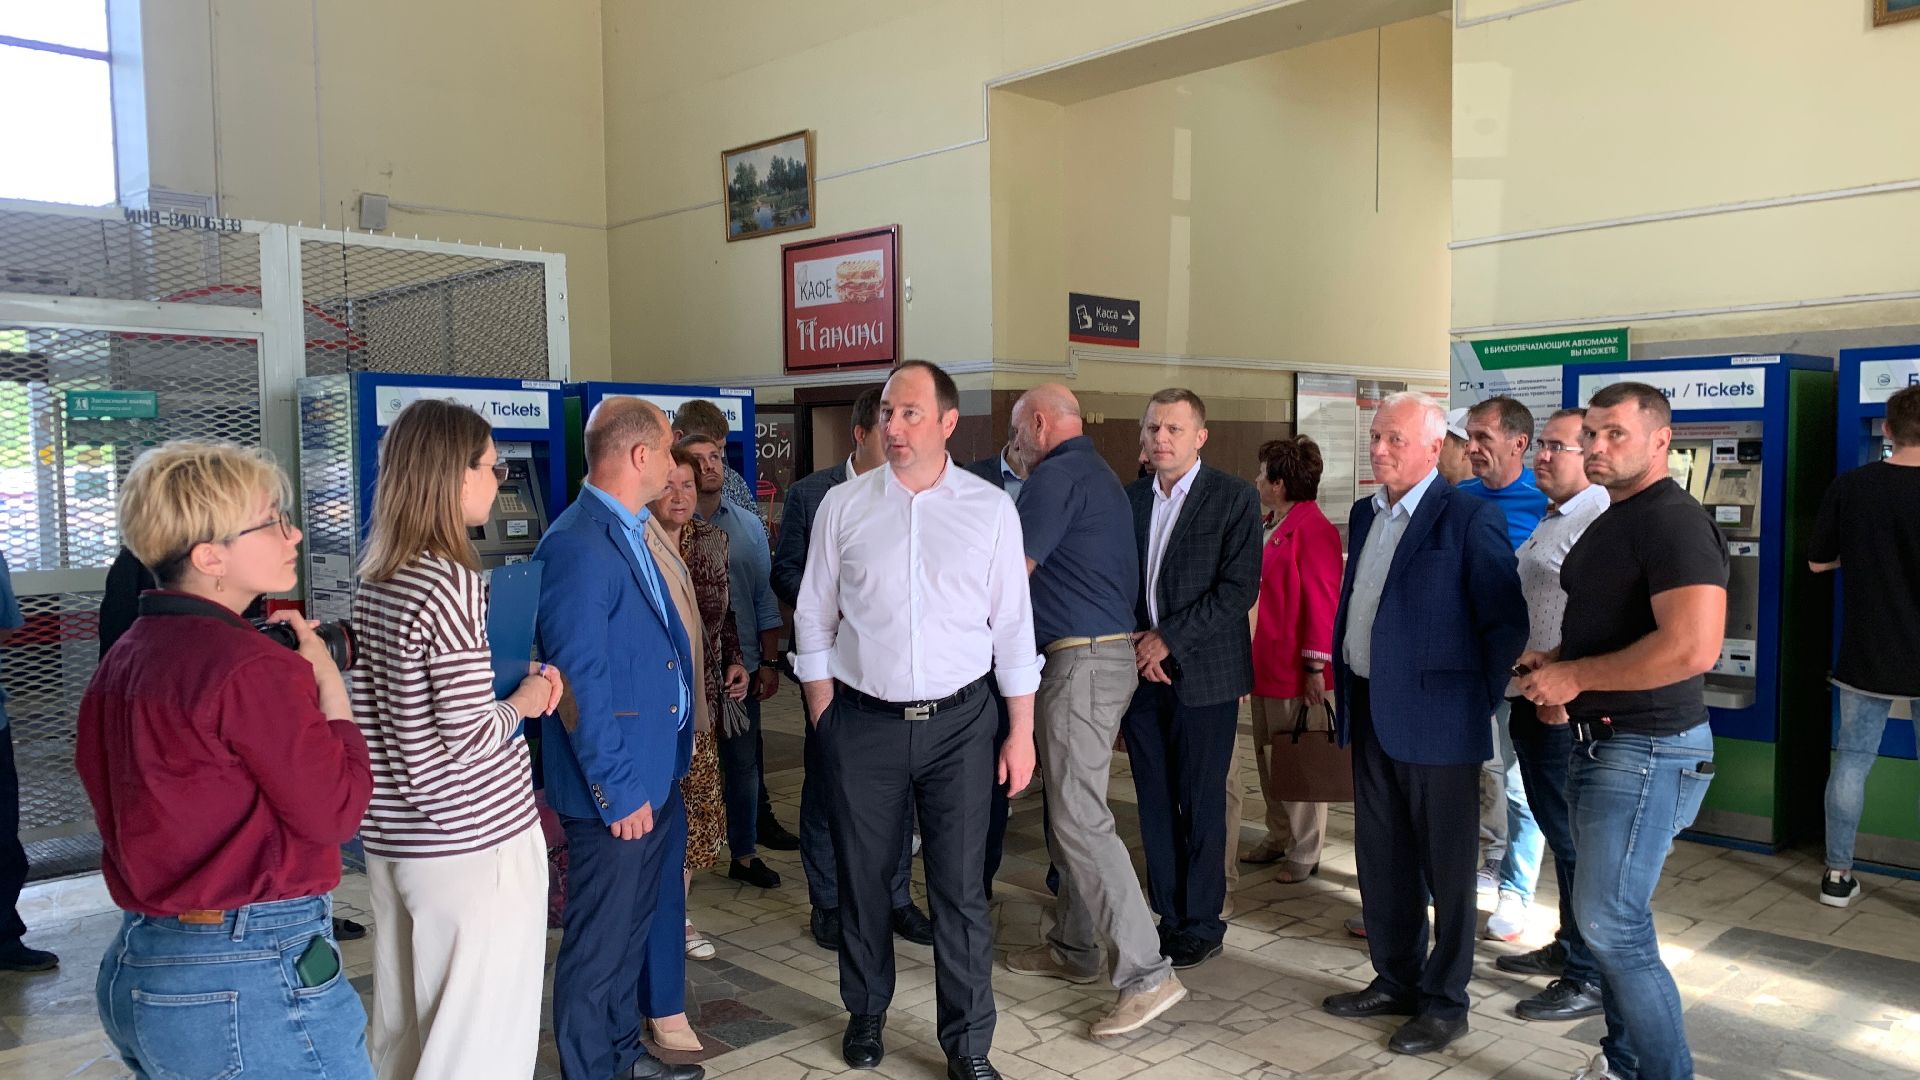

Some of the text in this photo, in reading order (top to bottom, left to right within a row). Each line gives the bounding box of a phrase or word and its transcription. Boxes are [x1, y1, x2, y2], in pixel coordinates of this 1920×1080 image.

[800, 278, 832, 301] КАФЕ
[1095, 305, 1119, 320] Касса
[796, 317, 883, 351] Панини
[1098, 322, 1118, 333] Tickets
[1490, 340, 1570, 354] БИЛЕТОПЕЧАТАЮЩИХ
[1572, 337, 1618, 347] АВТОМАТАХ
[1570, 349, 1582, 357] ВЫ
[1696, 381, 1755, 398] Tickets
[491, 402, 541, 417] Tickets
[755, 422, 778, 439] ФЕ
